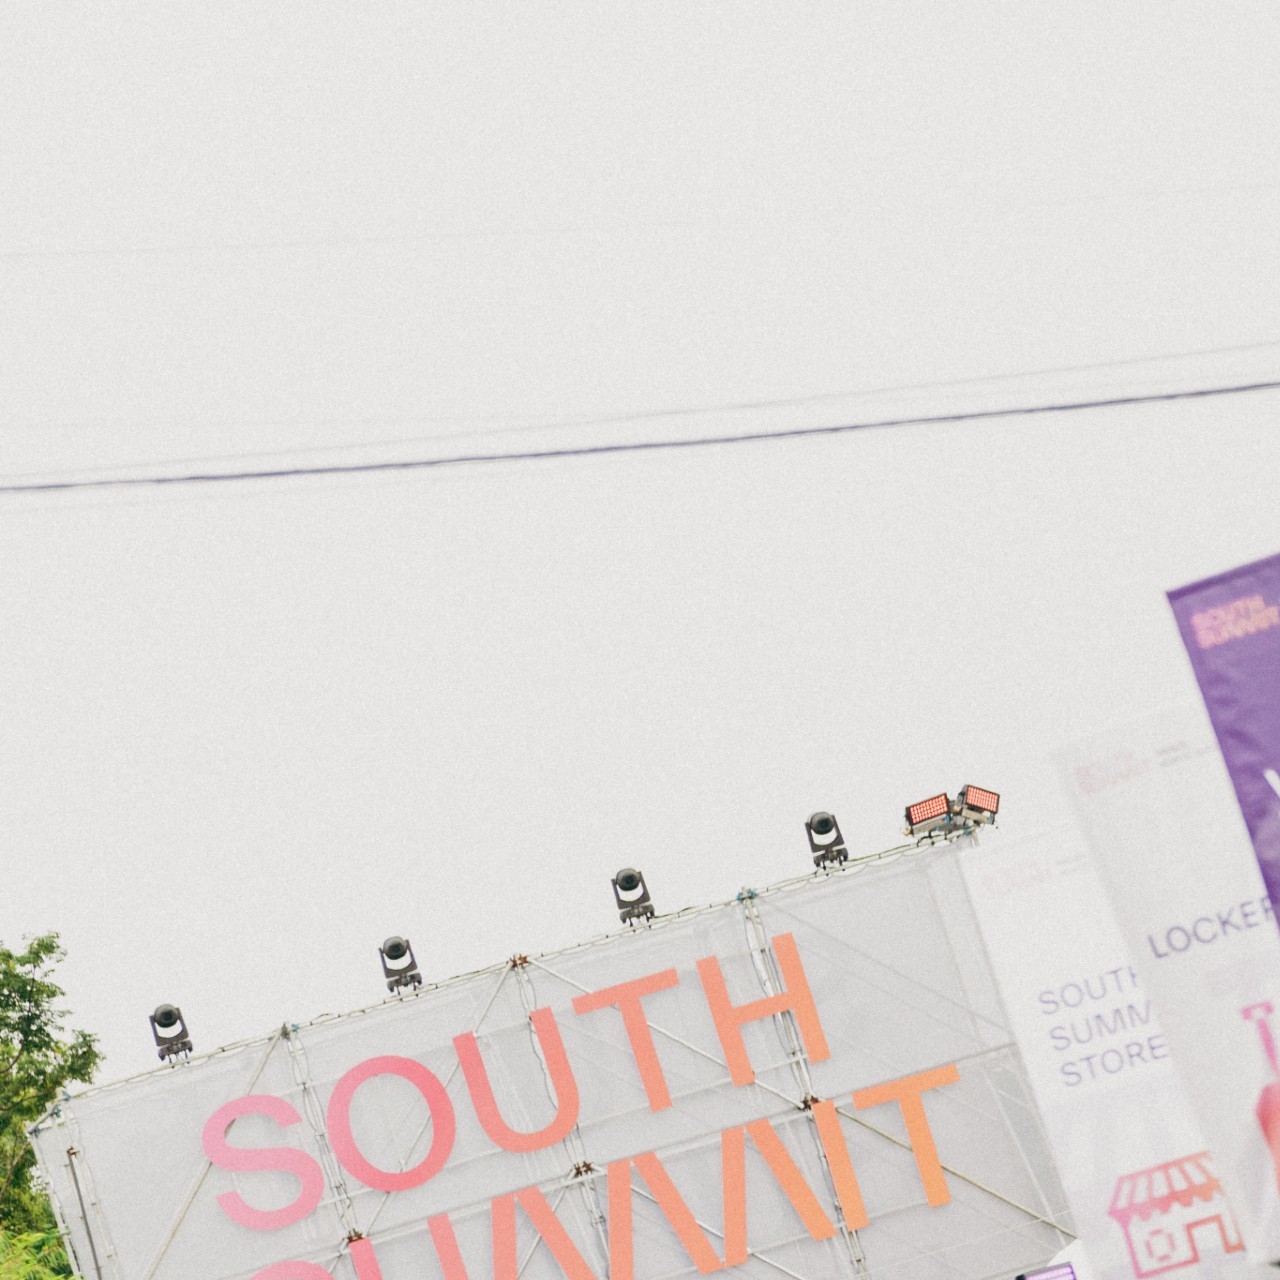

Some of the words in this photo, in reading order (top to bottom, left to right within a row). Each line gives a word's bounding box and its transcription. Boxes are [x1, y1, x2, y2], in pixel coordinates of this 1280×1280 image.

[1049, 1000, 1151, 1051] SUMM
[202, 932, 831, 1231] SOUTH
[1060, 1034, 1168, 1086] STORE
